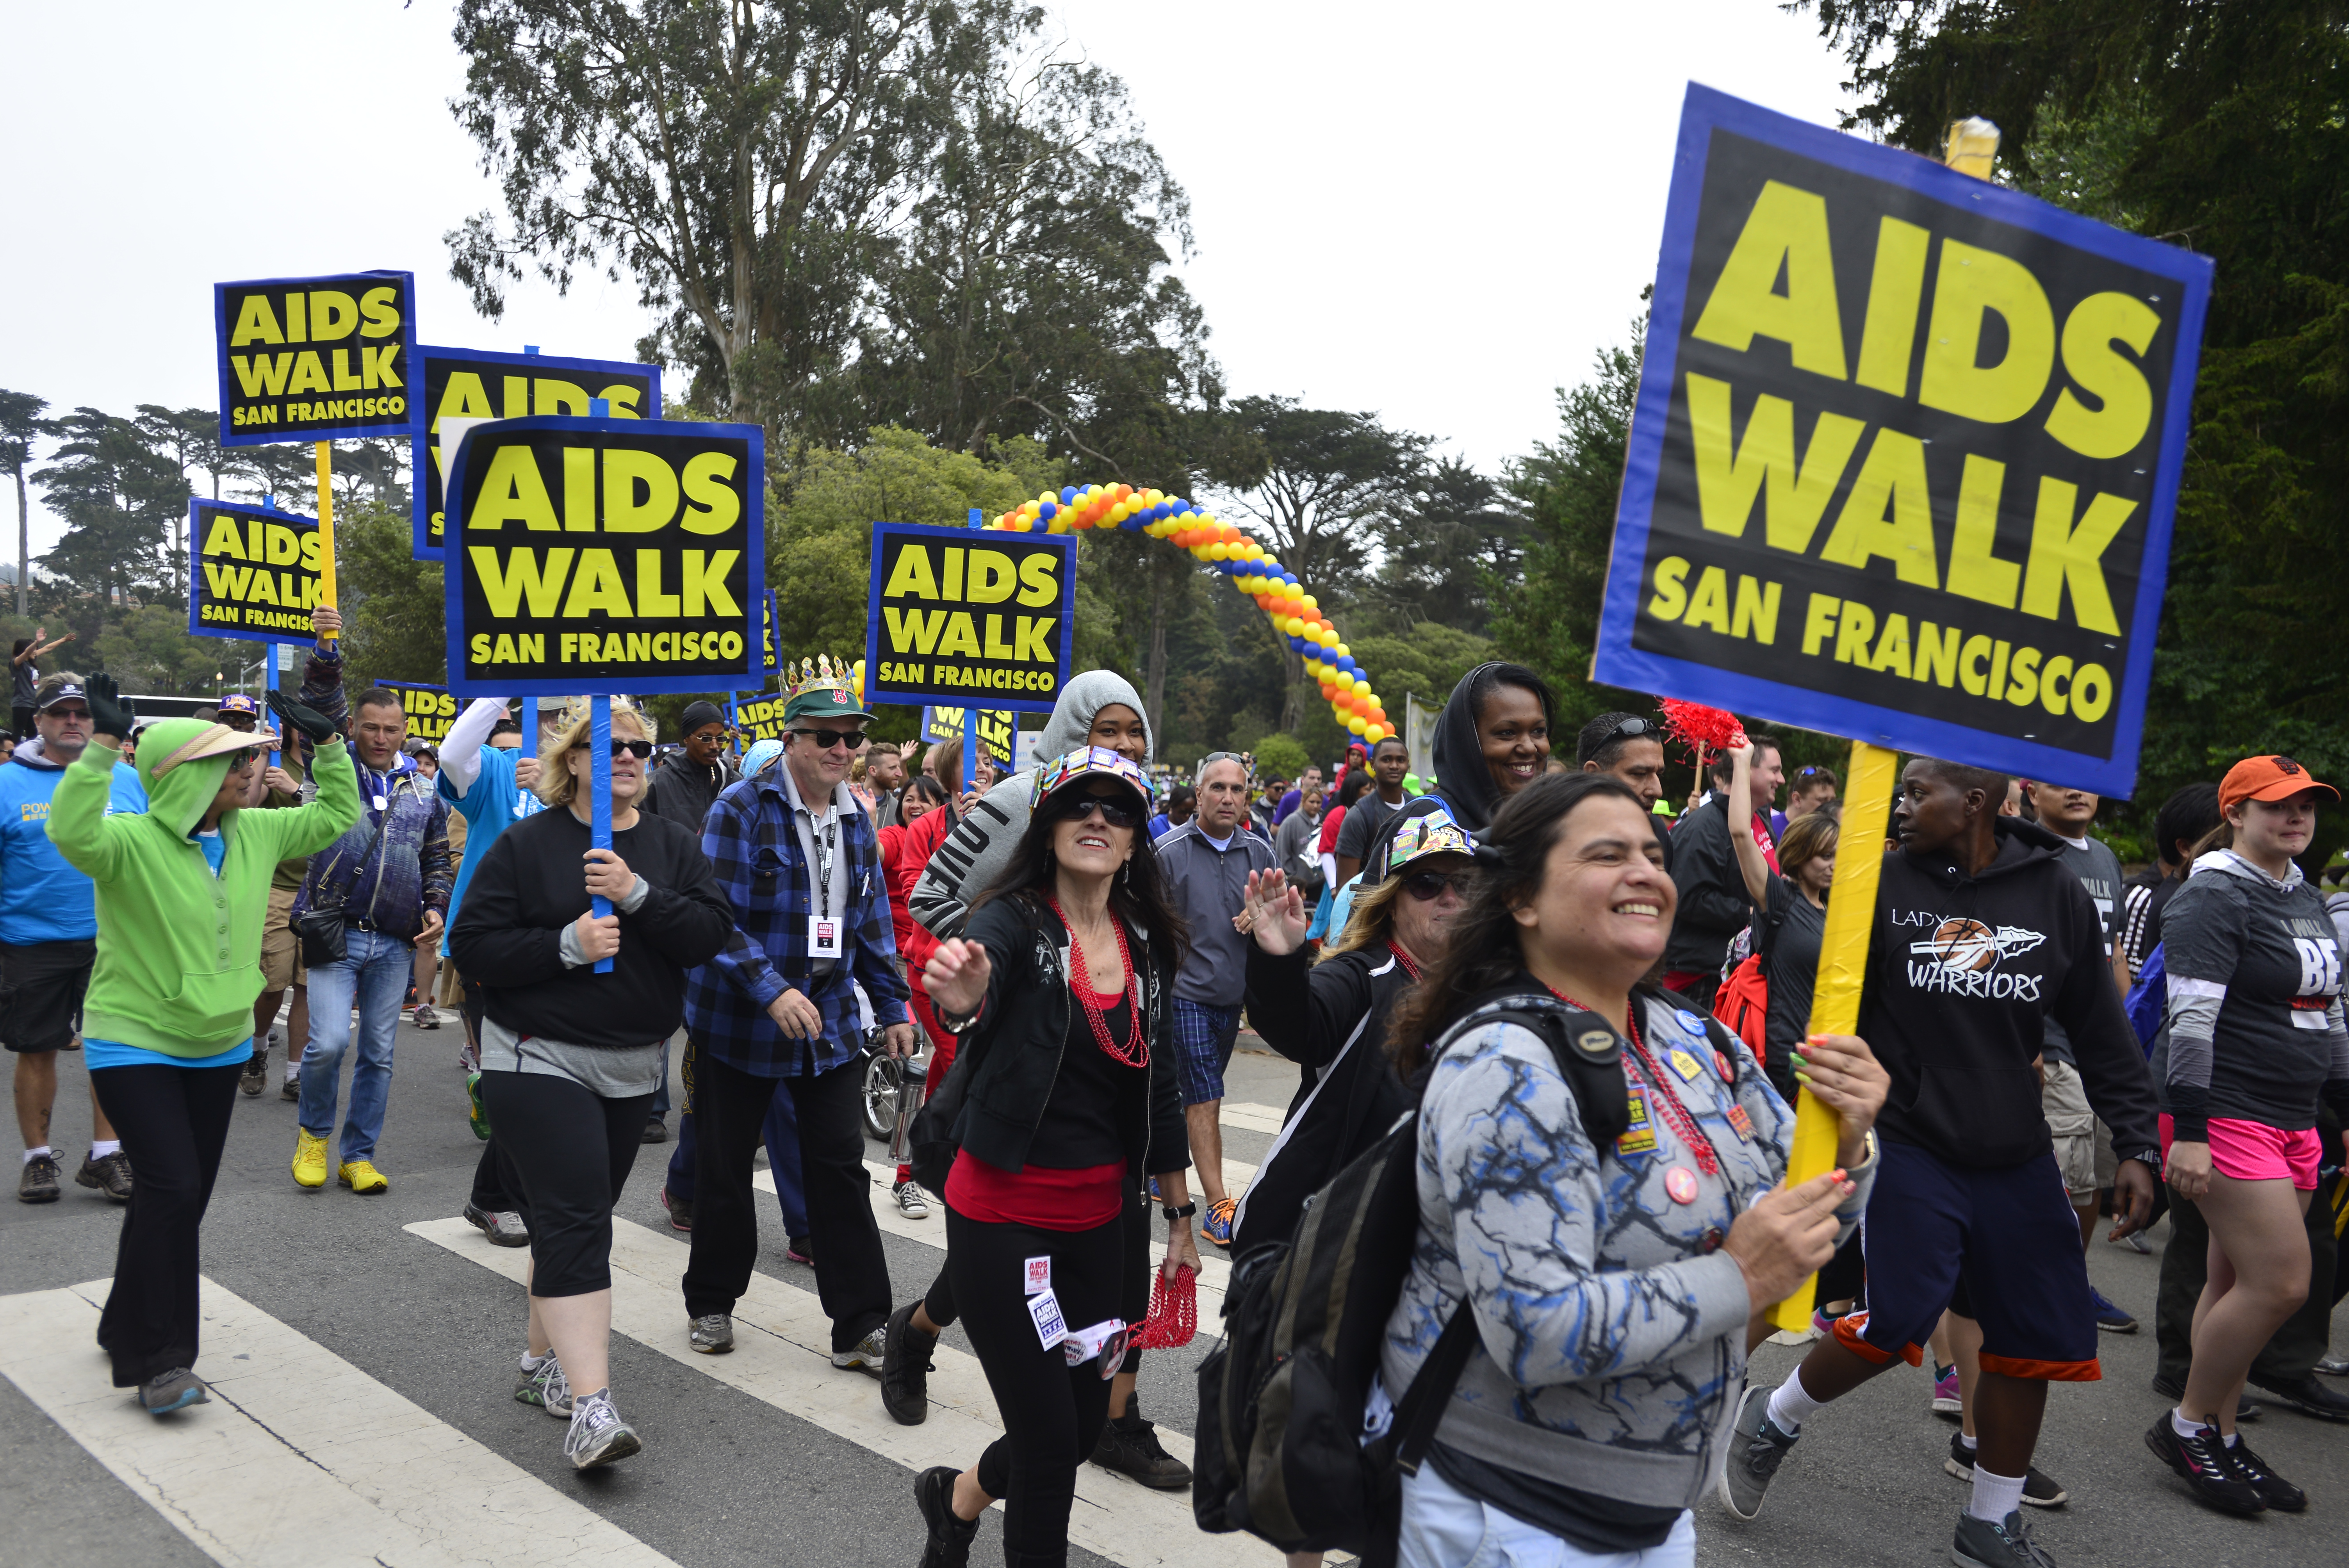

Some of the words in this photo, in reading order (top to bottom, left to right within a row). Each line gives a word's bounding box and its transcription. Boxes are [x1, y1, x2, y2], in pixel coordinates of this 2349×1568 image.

[230, 287, 400, 347] AIDS
[1691, 178, 2162, 460] AIDS
[230, 345, 404, 397] WALK
[233, 404, 278, 426] SAN
[287, 396, 405, 422] FRANCISCO
[431, 371, 641, 434] AIDS
[467, 445, 740, 535] AIDS
[1685, 371, 2139, 637] WALK
[203, 515, 321, 572] AIDS
[203, 562, 323, 610] WALK
[468, 546, 743, 618] WALK
[884, 544, 1058, 608] AIDS
[201, 604, 239, 622] SAN
[471, 633, 545, 664] SAN
[560, 631, 743, 663] FRANCISCO
[883, 606, 1057, 663] WALK
[1647, 556, 1782, 645] SAN
[1801, 592, 2112, 723] FRANCISCO
[879, 661, 925, 684] SAN
[934, 665, 1055, 692] FRANCISCO
[737, 698, 785, 725] AIDS
[406, 716, 454, 738] ALK
[930, 723, 954, 738] SAN
[1397, 834, 1413, 843] AIDS
[1397, 840, 1413, 848] WALK
[2081, 877, 2112, 898] WALK
[1892, 909, 1949, 929] LADY
[2093, 898, 2113, 956] E
[2290, 918, 2328, 937] WALK
[1907, 959, 2042, 1002] WARRIORS
[2293, 937, 2343, 996] BE
[1627, 1099, 1643, 1111] DS
[1029, 1261, 1048, 1270] AIDS
[1029, 1268, 1048, 1278] WALK
[1036, 1300, 1055, 1318] AIDS
[1041, 1295, 1052, 1305] Annual
[1037, 1308, 1058, 1324] WALK
[1045, 1338, 1056, 1346] PACIFIC
[1066, 1345, 1084, 1355] LOVE
